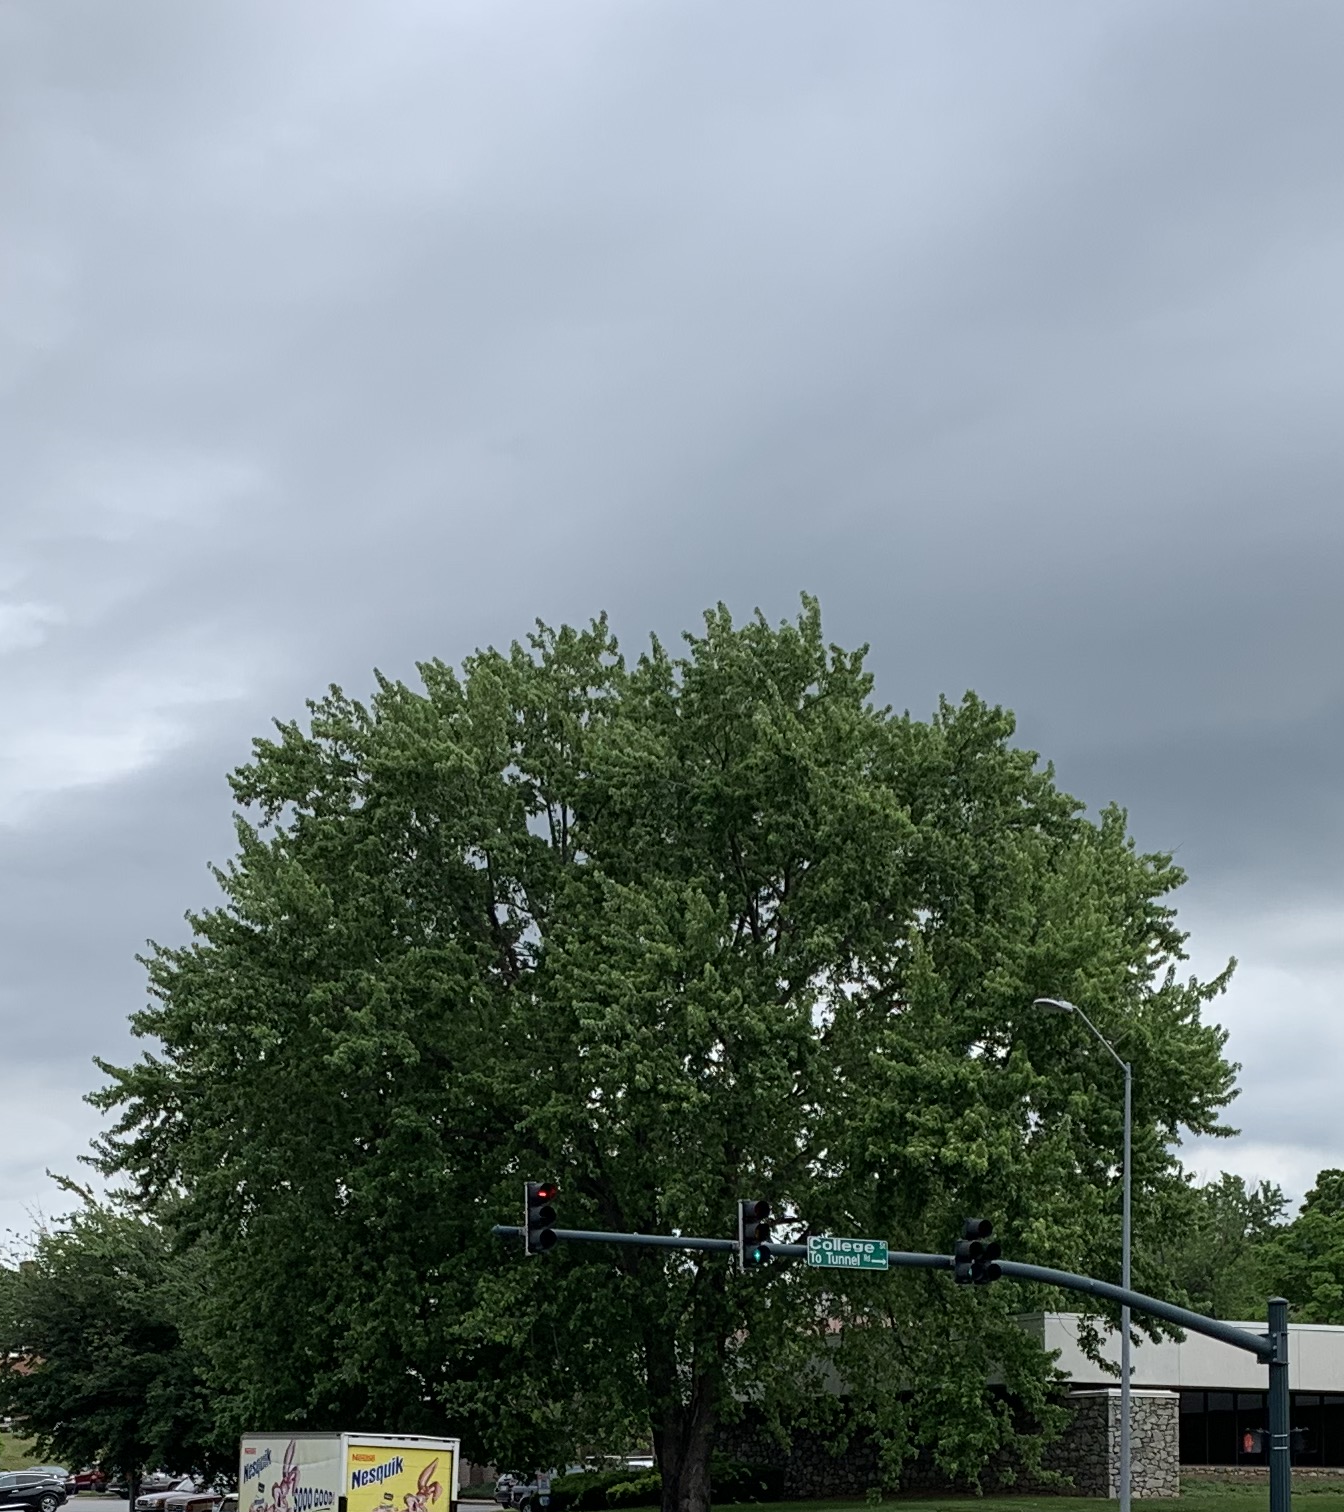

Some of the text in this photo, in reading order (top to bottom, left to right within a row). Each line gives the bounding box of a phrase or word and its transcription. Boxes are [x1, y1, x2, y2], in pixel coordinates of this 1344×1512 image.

[809, 1238, 875, 1254] College
[809, 1251, 822, 1264] To
[826, 1252, 861, 1266] Tunnel
[351, 1456, 404, 1491] Nesquik
